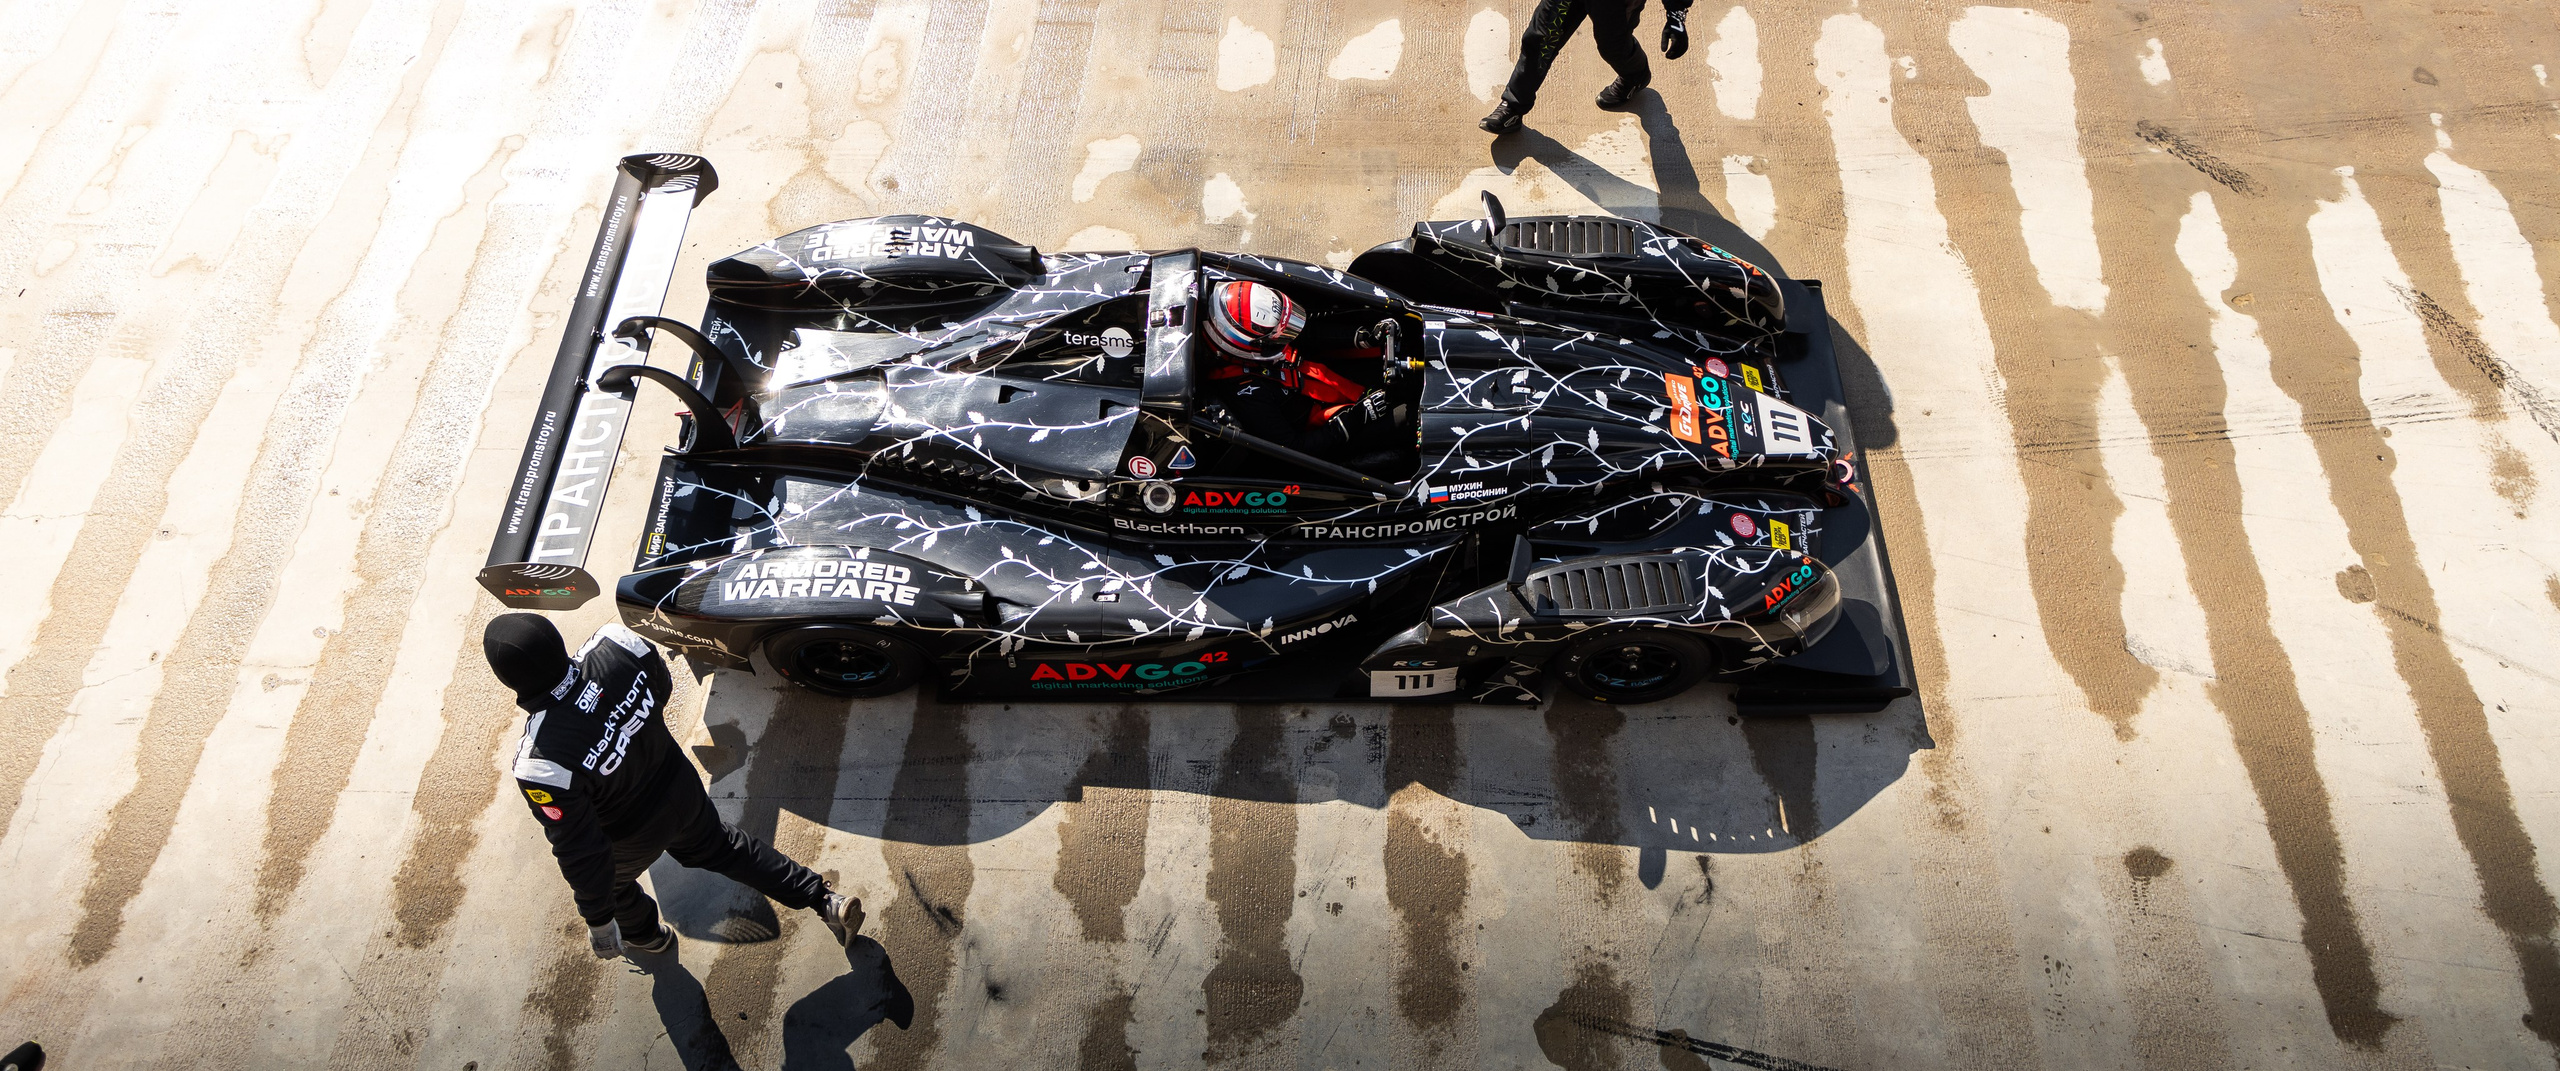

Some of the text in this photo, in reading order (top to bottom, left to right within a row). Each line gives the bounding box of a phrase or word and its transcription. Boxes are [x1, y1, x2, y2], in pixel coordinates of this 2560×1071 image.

[586, 195, 628, 297] www.transpromstroy.ru
[1064, 330, 1134, 348] terasms
[1701, 376, 1730, 458] ADVGO
[1770, 409, 1802, 443] 111
[507, 410, 557, 534] www.transpromstroy.ru
[1137, 460, 1148, 475] E
[1183, 485, 1300, 506] ADVGO 42
[1449, 481, 1483, 492] МУХИН
[1450, 487, 1508, 501] ЕФРОСИНИН
[1114, 518, 1244, 534] Blackthorn
[1300, 504, 1517, 539] ТРАНСПРОМСТРОЙ
[649, 535, 662, 555] МИР
[735, 560, 911, 584] ARMORED
[505, 588, 571, 596] ADVGO
[724, 578, 921, 607] WARFARE
[1763, 564, 1813, 610] ADVGO
[1281, 613, 1358, 645] INNOVA
[1030, 651, 1229, 681] ADVGO 42
[578, 682, 600, 710] OMP
[1031, 674, 1208, 690] digital marketing solutions
[1394, 674, 1435, 690] 111
[582, 670, 648, 771] Blackthorn
[599, 688, 655, 776] CREW
